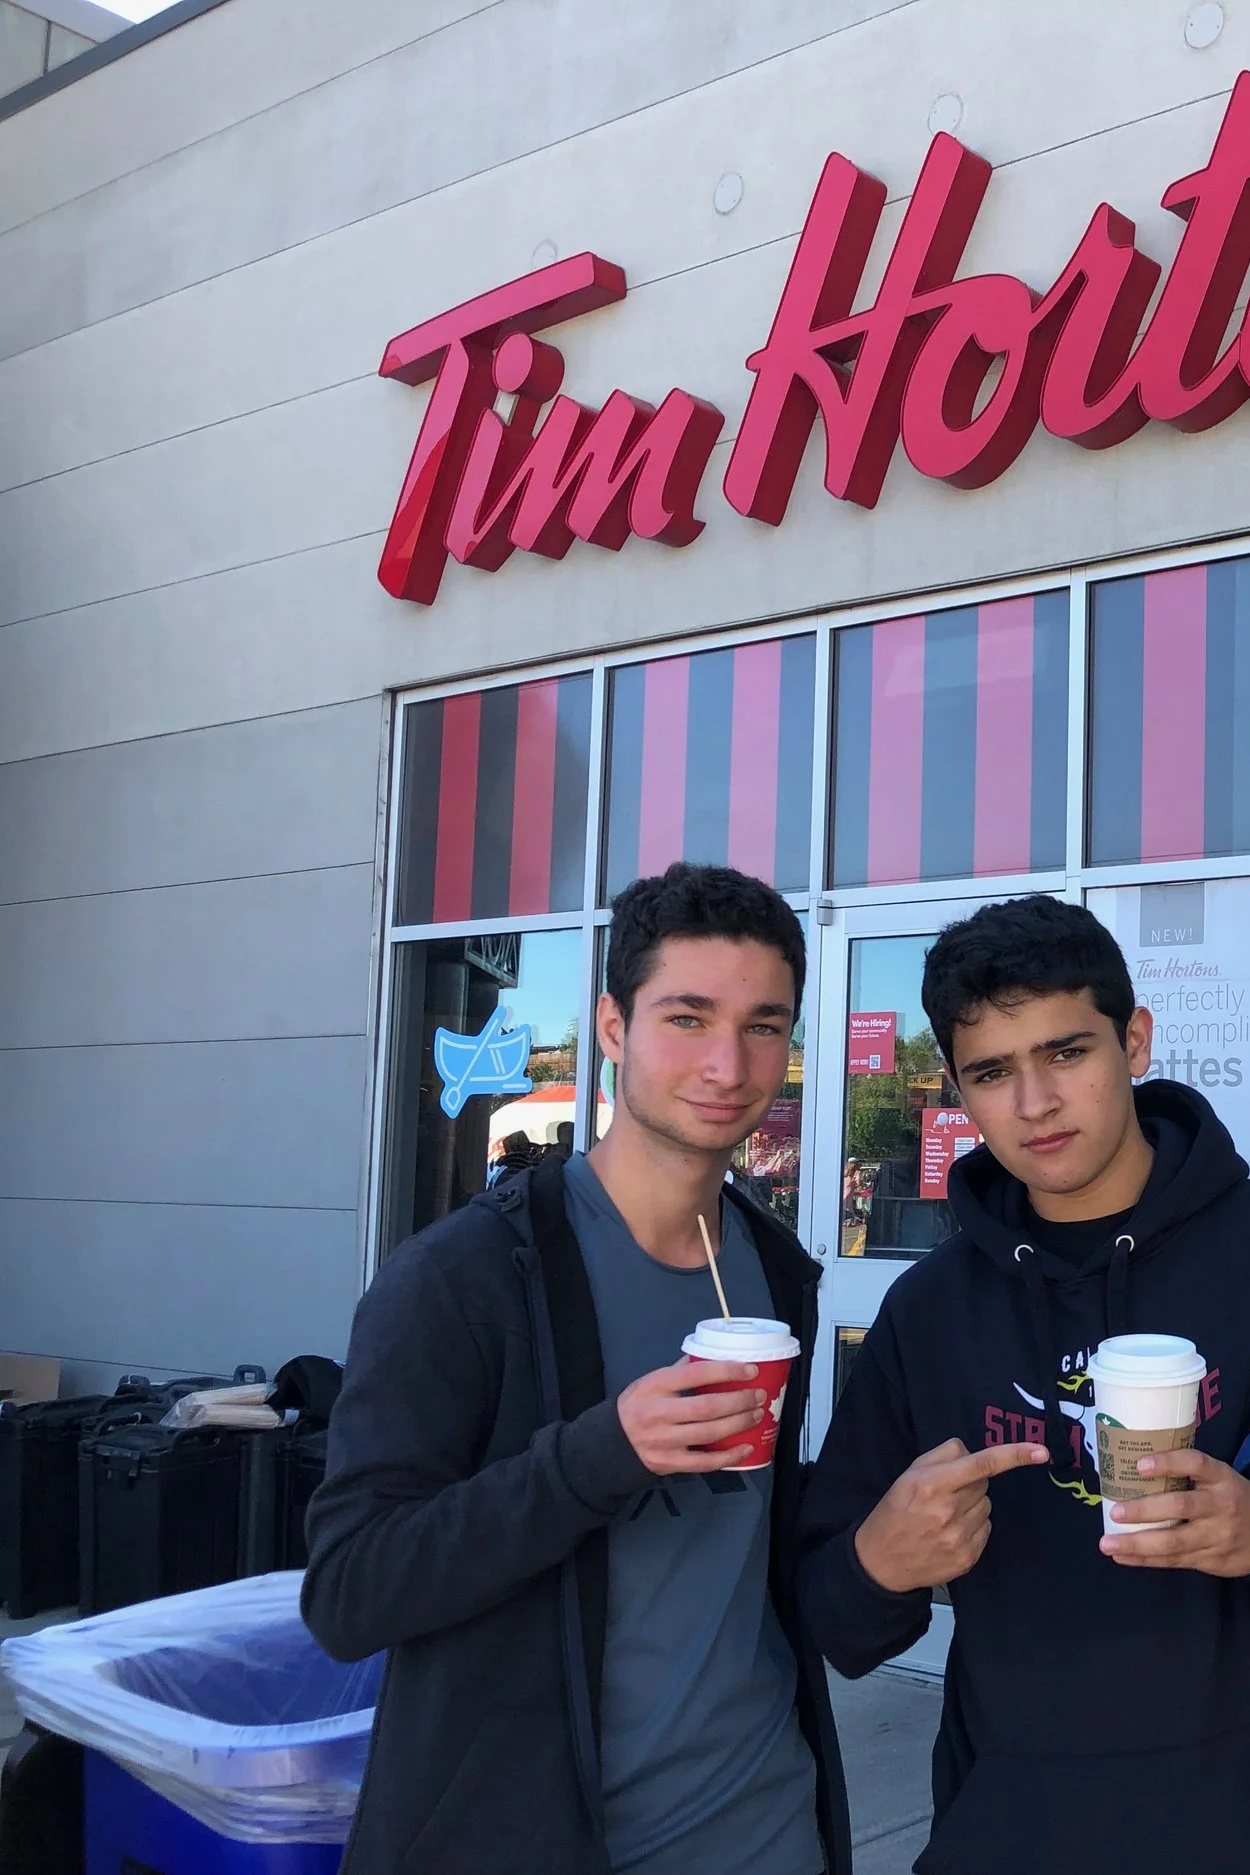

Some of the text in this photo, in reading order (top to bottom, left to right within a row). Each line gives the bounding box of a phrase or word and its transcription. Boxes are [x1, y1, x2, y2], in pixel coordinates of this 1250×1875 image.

[378, 252, 726, 605] Tim
[1151, 927, 1193, 943] NEW!
[1136, 958, 1161, 979] Tim
[851, 1018, 892, 1029] We're Hiring!
[1137, 1049, 1243, 1087] attes
